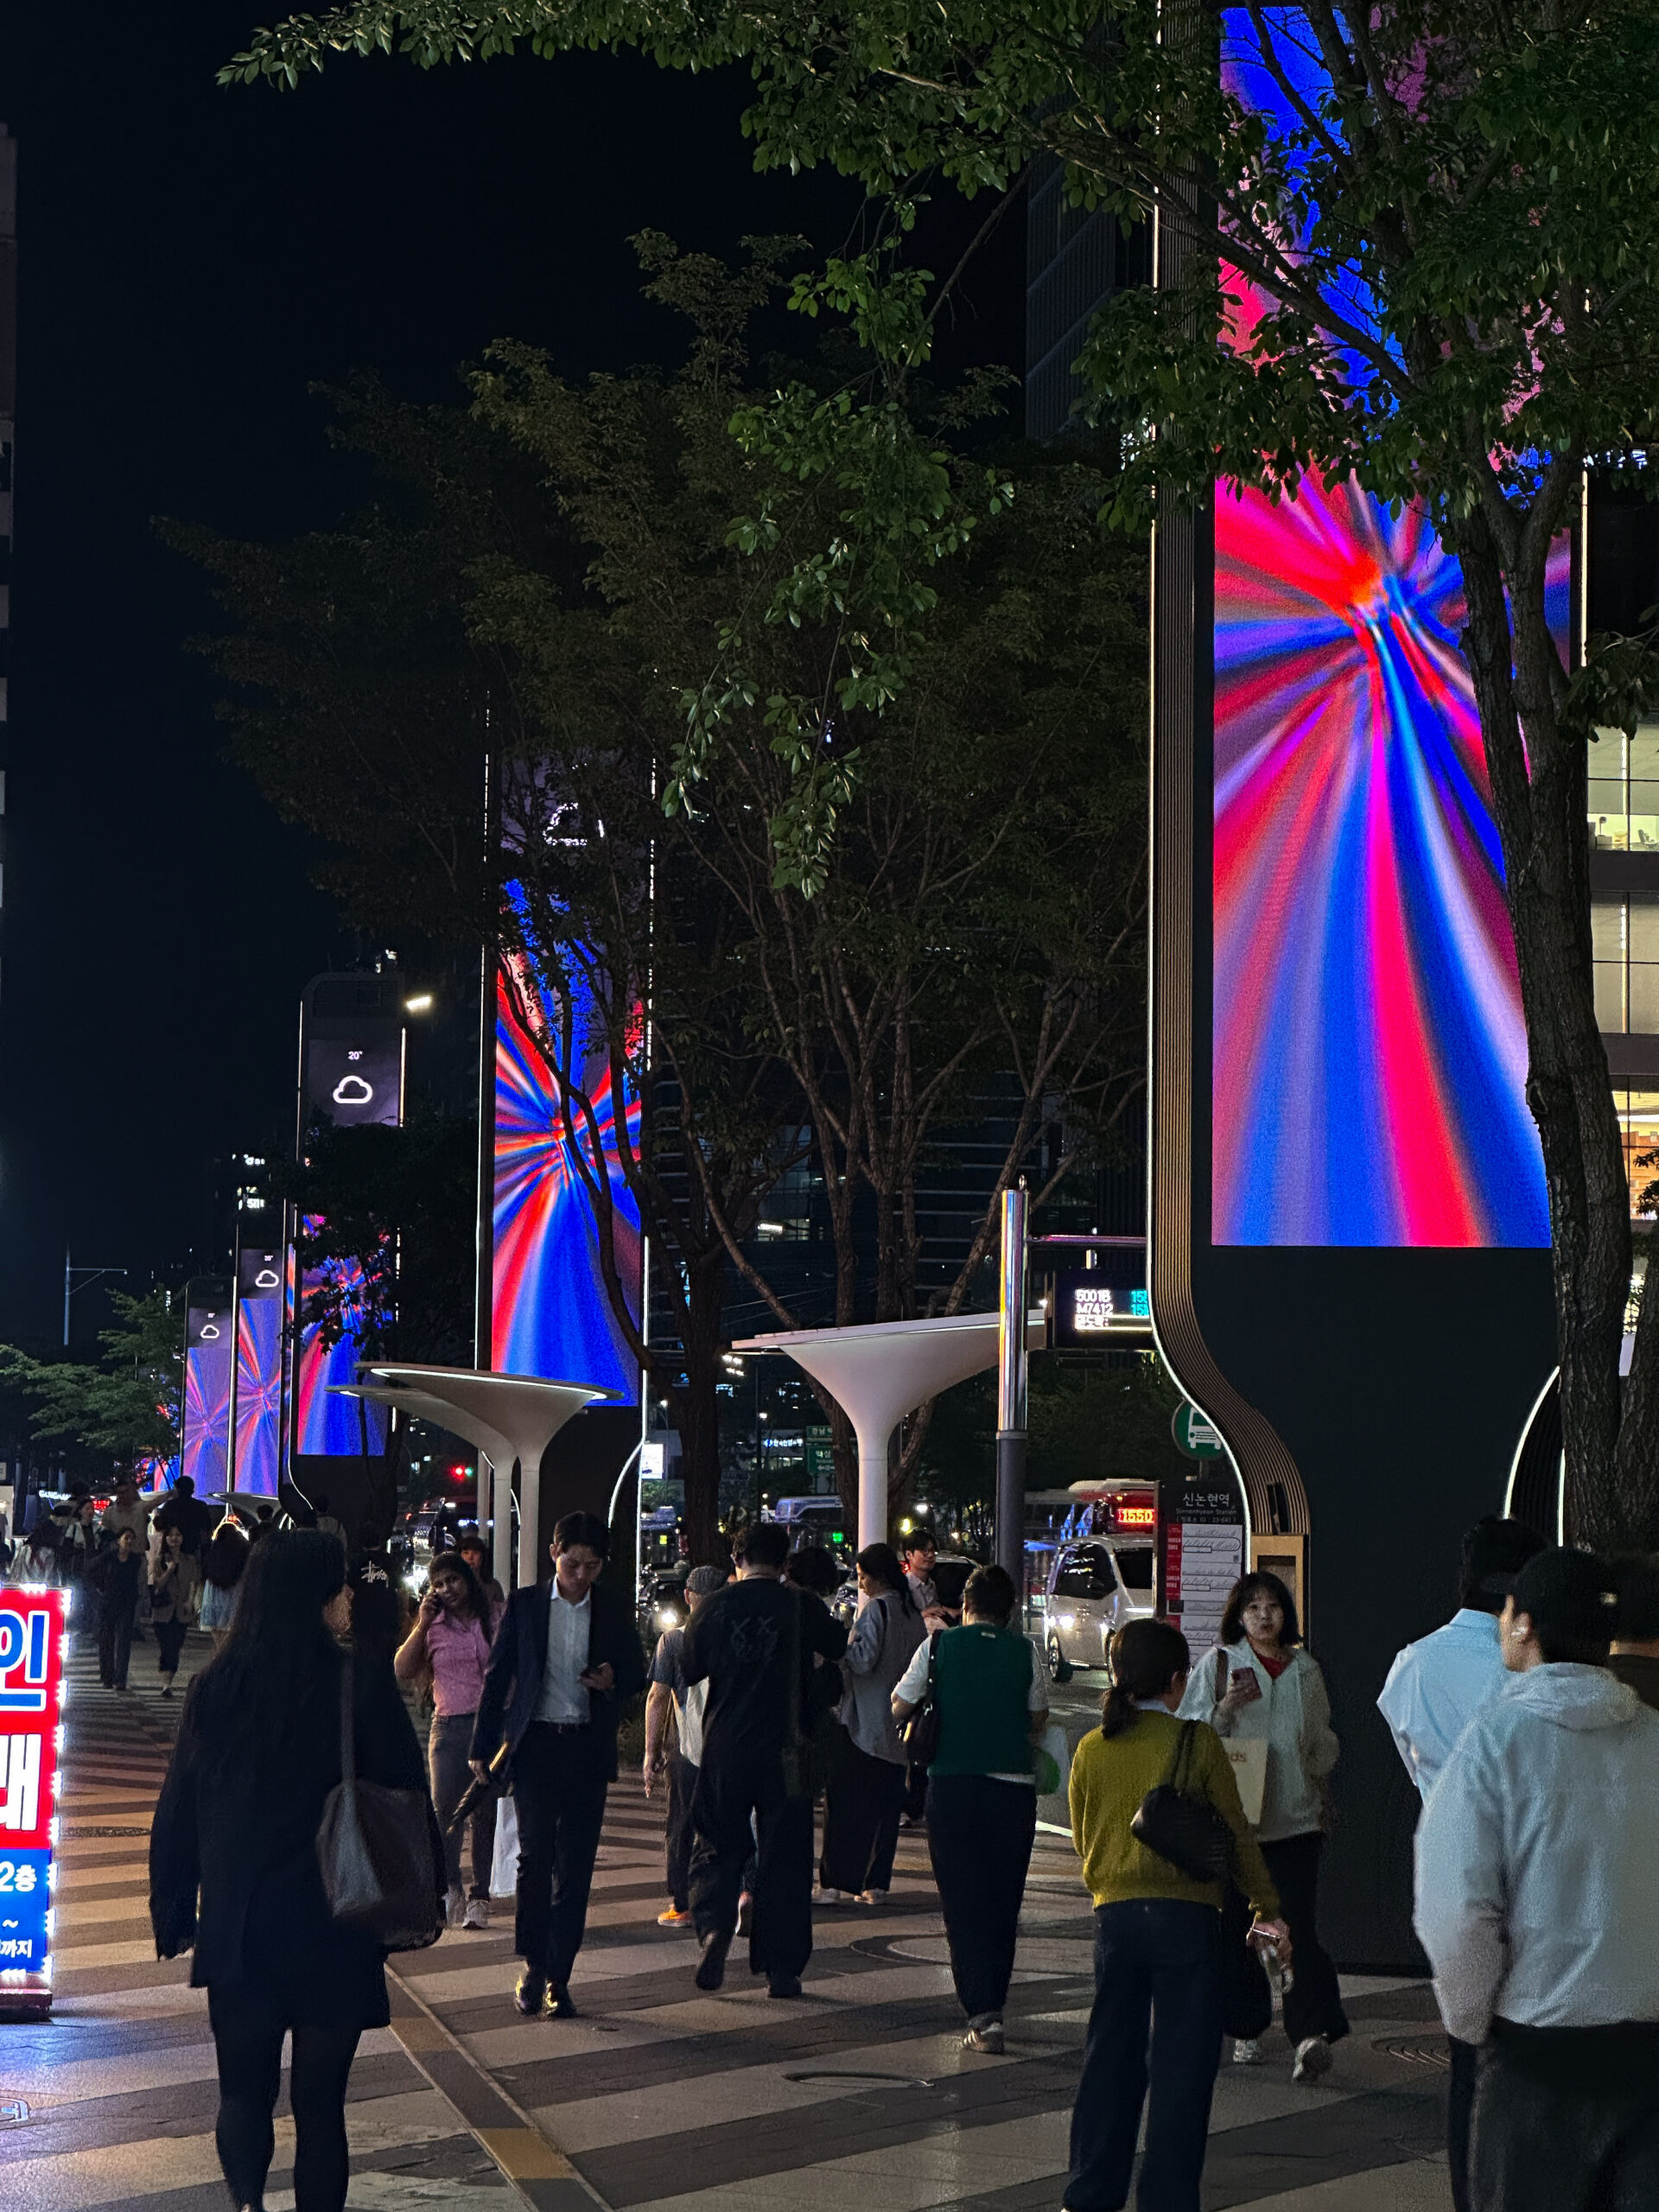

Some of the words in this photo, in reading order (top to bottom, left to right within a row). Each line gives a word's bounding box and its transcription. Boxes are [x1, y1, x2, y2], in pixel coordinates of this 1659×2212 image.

[1076, 1302, 1114, 1315] M7412
[1183, 1492, 1230, 1507] 신논현역
[1122, 1510, 1153, 1523] 1550
[0, 1861, 37, 1892] 2층
